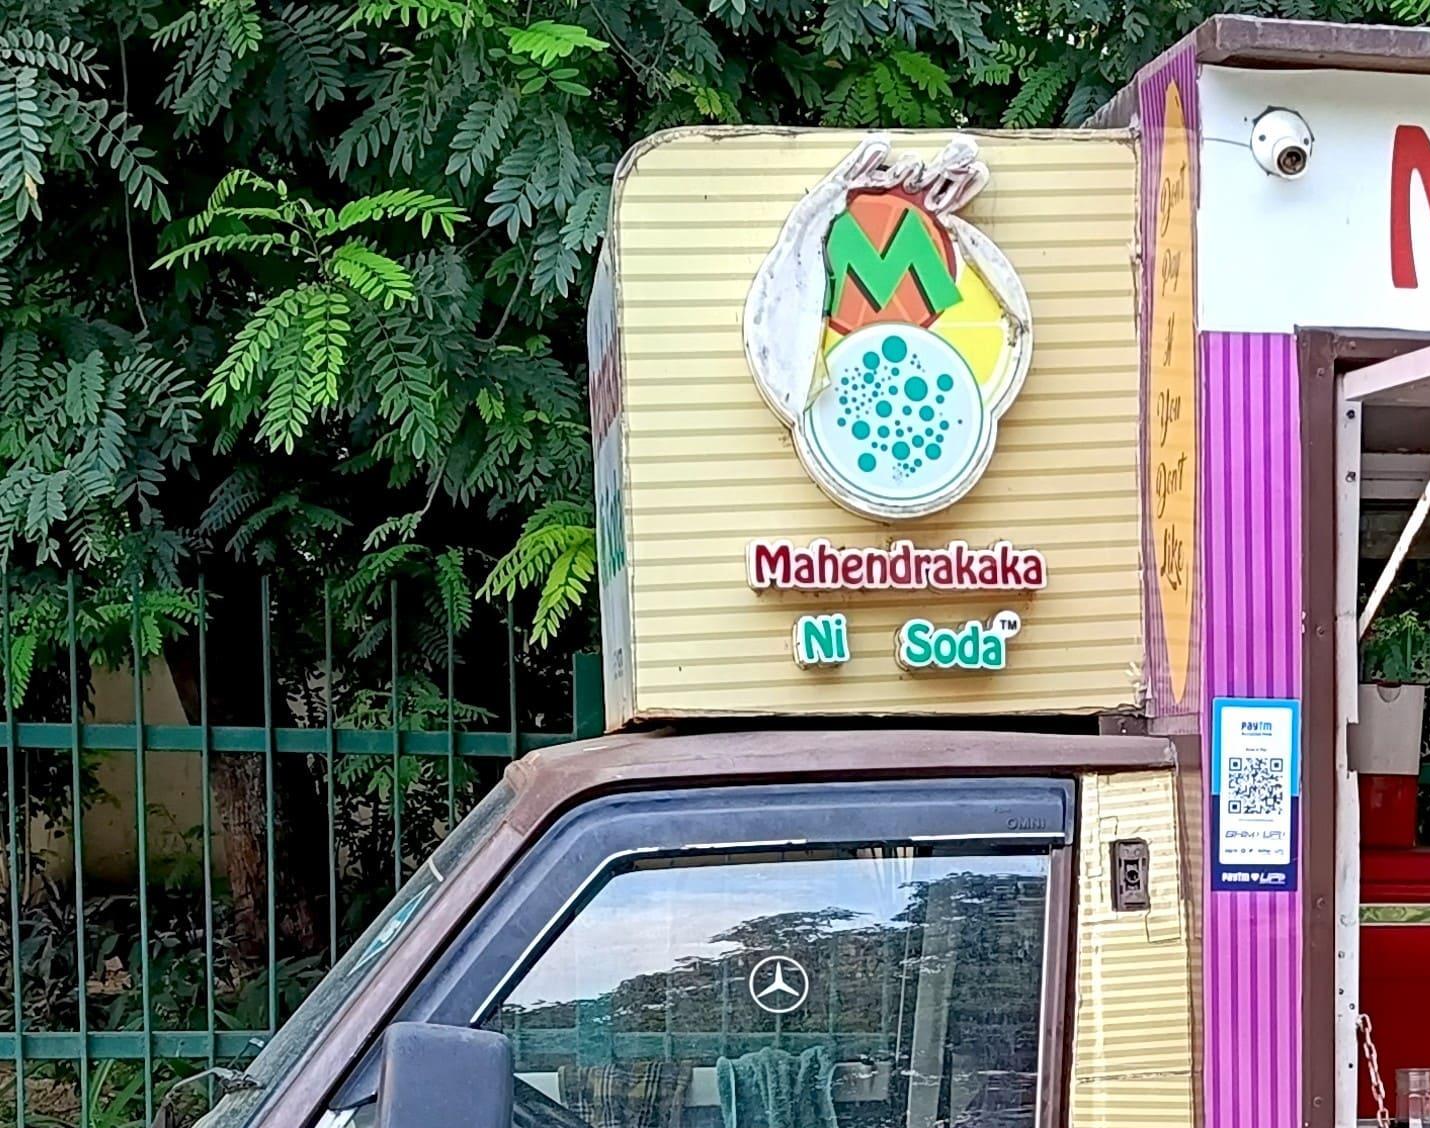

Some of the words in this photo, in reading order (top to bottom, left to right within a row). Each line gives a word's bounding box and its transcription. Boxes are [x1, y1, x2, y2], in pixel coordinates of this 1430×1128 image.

[753, 544, 1044, 588] Mahendrakaka
[802, 618, 846, 660] Ni
[903, 623, 1003, 666] Soda
[1000, 620, 1018, 630] TM
[1008, 819, 1046, 830] OMNI
